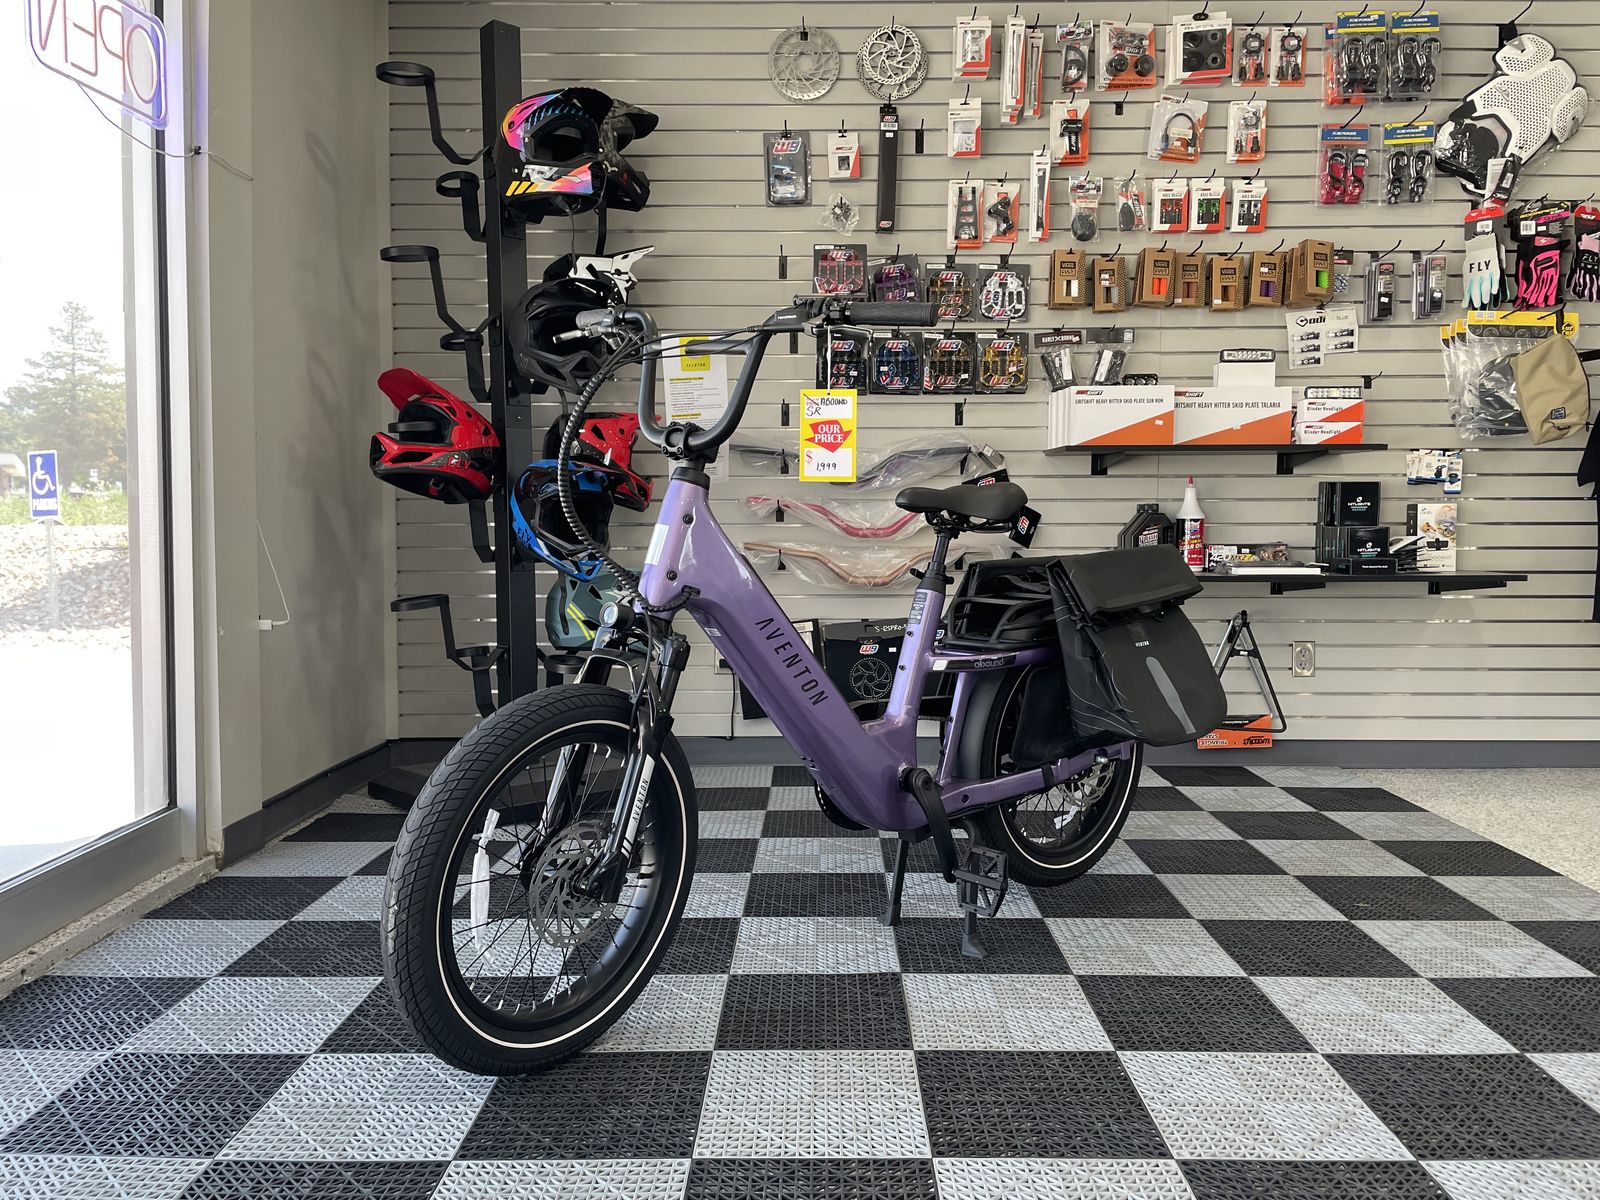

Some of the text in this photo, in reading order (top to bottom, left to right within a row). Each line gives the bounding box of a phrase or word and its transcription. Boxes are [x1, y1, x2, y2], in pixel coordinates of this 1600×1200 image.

[1582, 253, 1599, 261] FLY
[1469, 259, 1492, 273] FLY
[806, 405, 822, 417] SR
[818, 424, 841, 434] OUR
[814, 433, 844, 443] PRICE
[805, 449, 813, 464] $
[816, 462, 837, 472] 1,999
[859, 644, 880, 655] W9
[755, 617, 829, 706] AVENTON
[974, 657, 1004, 669] abound
[632, 778, 649, 823] AVENTON
